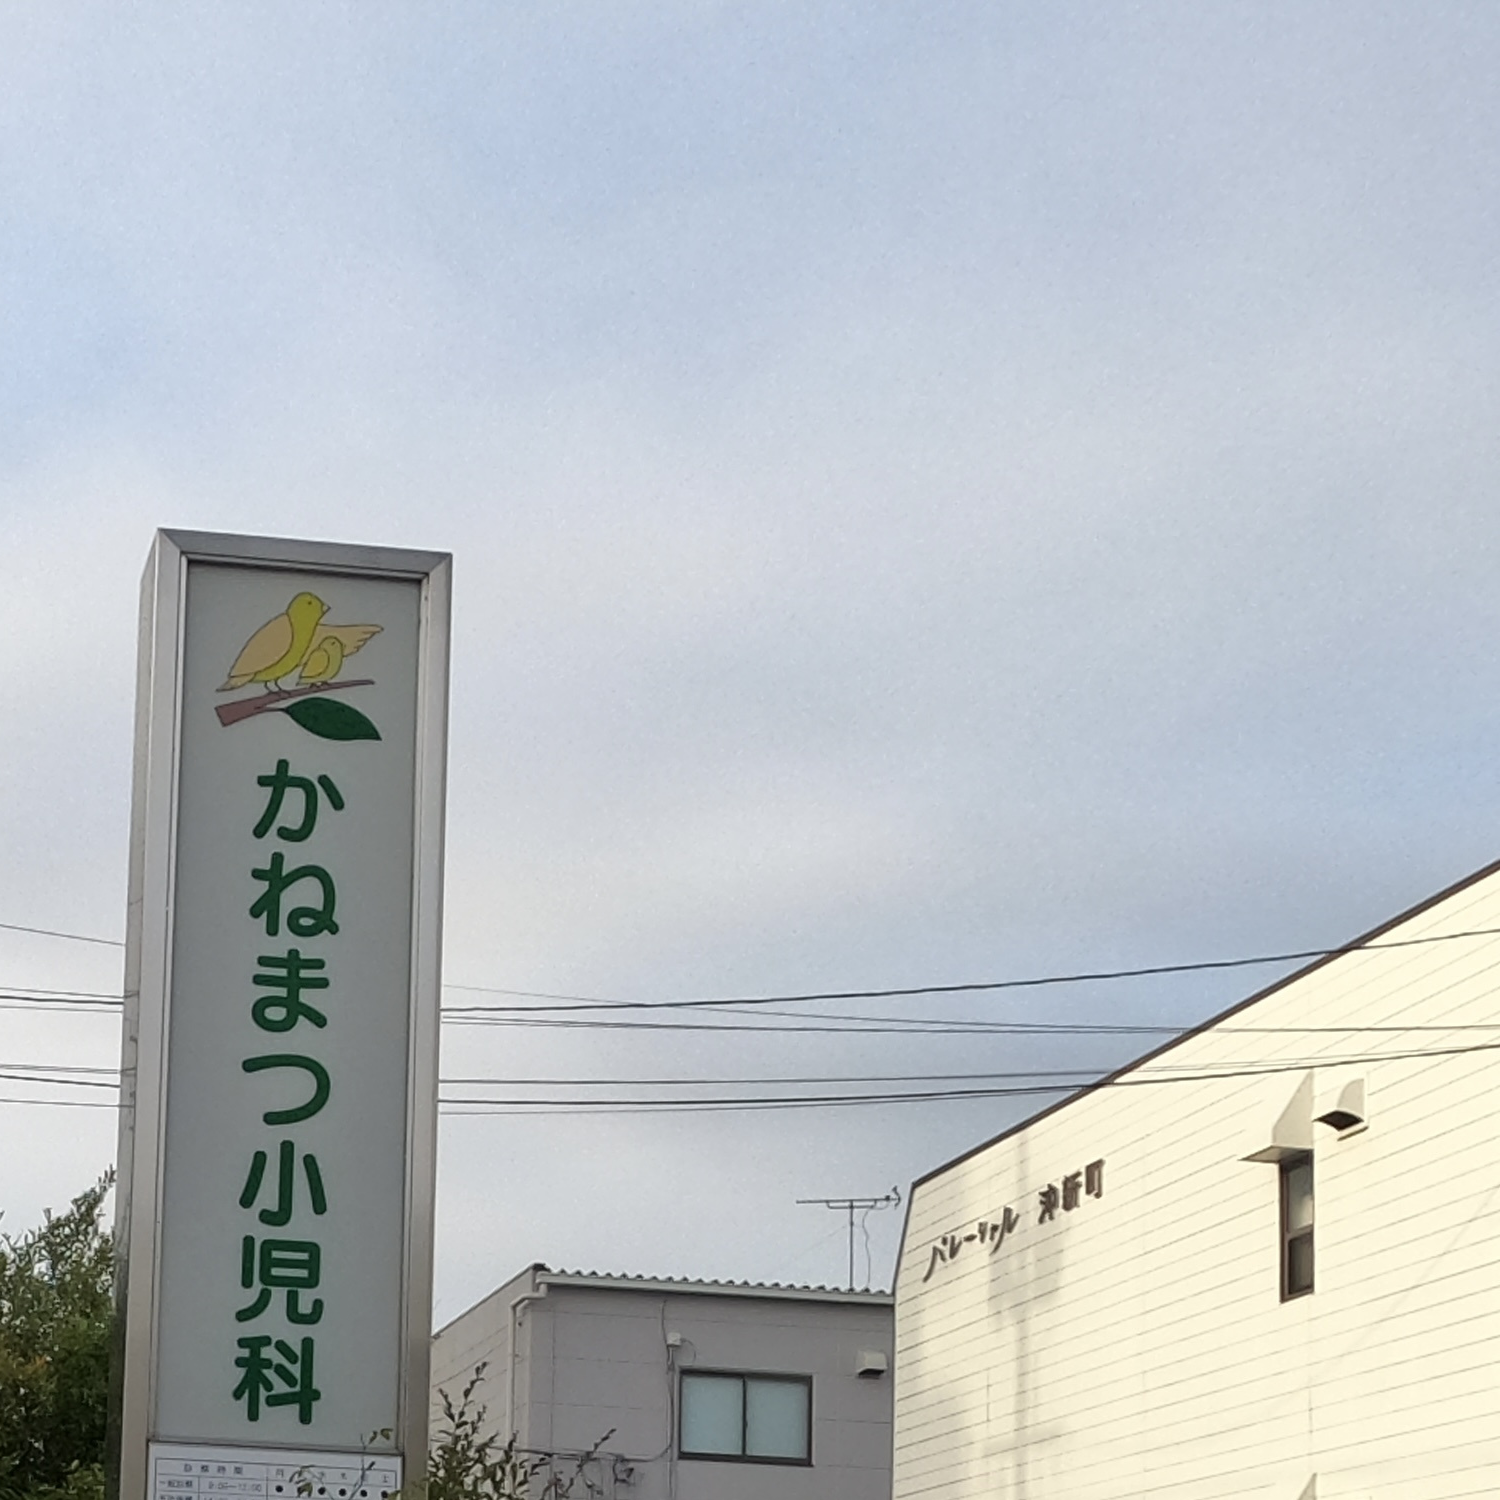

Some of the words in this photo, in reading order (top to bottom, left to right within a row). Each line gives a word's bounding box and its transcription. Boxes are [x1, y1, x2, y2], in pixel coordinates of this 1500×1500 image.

[232, 758, 345, 1426] かねまつ小児科
